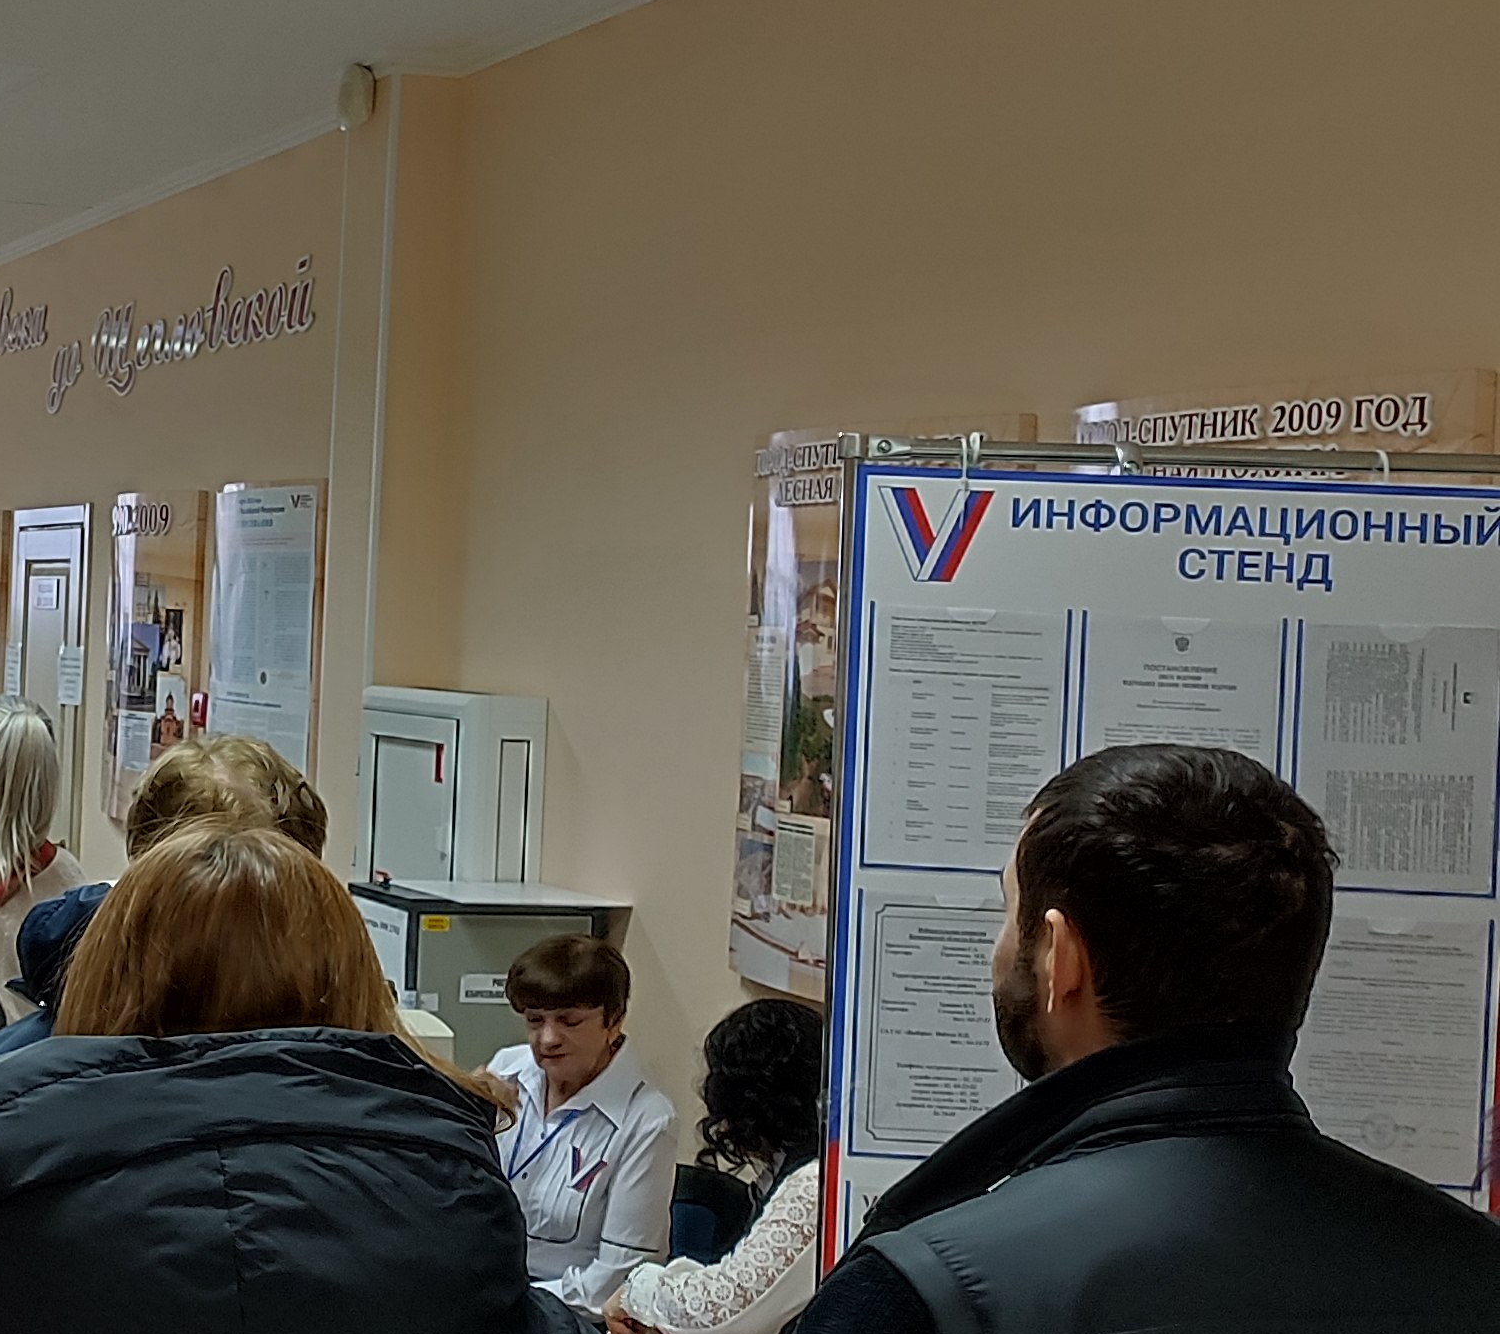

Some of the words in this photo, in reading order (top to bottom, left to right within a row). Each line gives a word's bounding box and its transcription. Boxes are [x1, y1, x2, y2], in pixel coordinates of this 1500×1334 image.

[1271, 400, 1342, 434] 2009
[1353, 395, 1429, 434] ГОД
[1011, 497, 1500, 547] ИНФОРМАЦИОННЫЙ
[1178, 548, 1333, 593] СТЕНД
